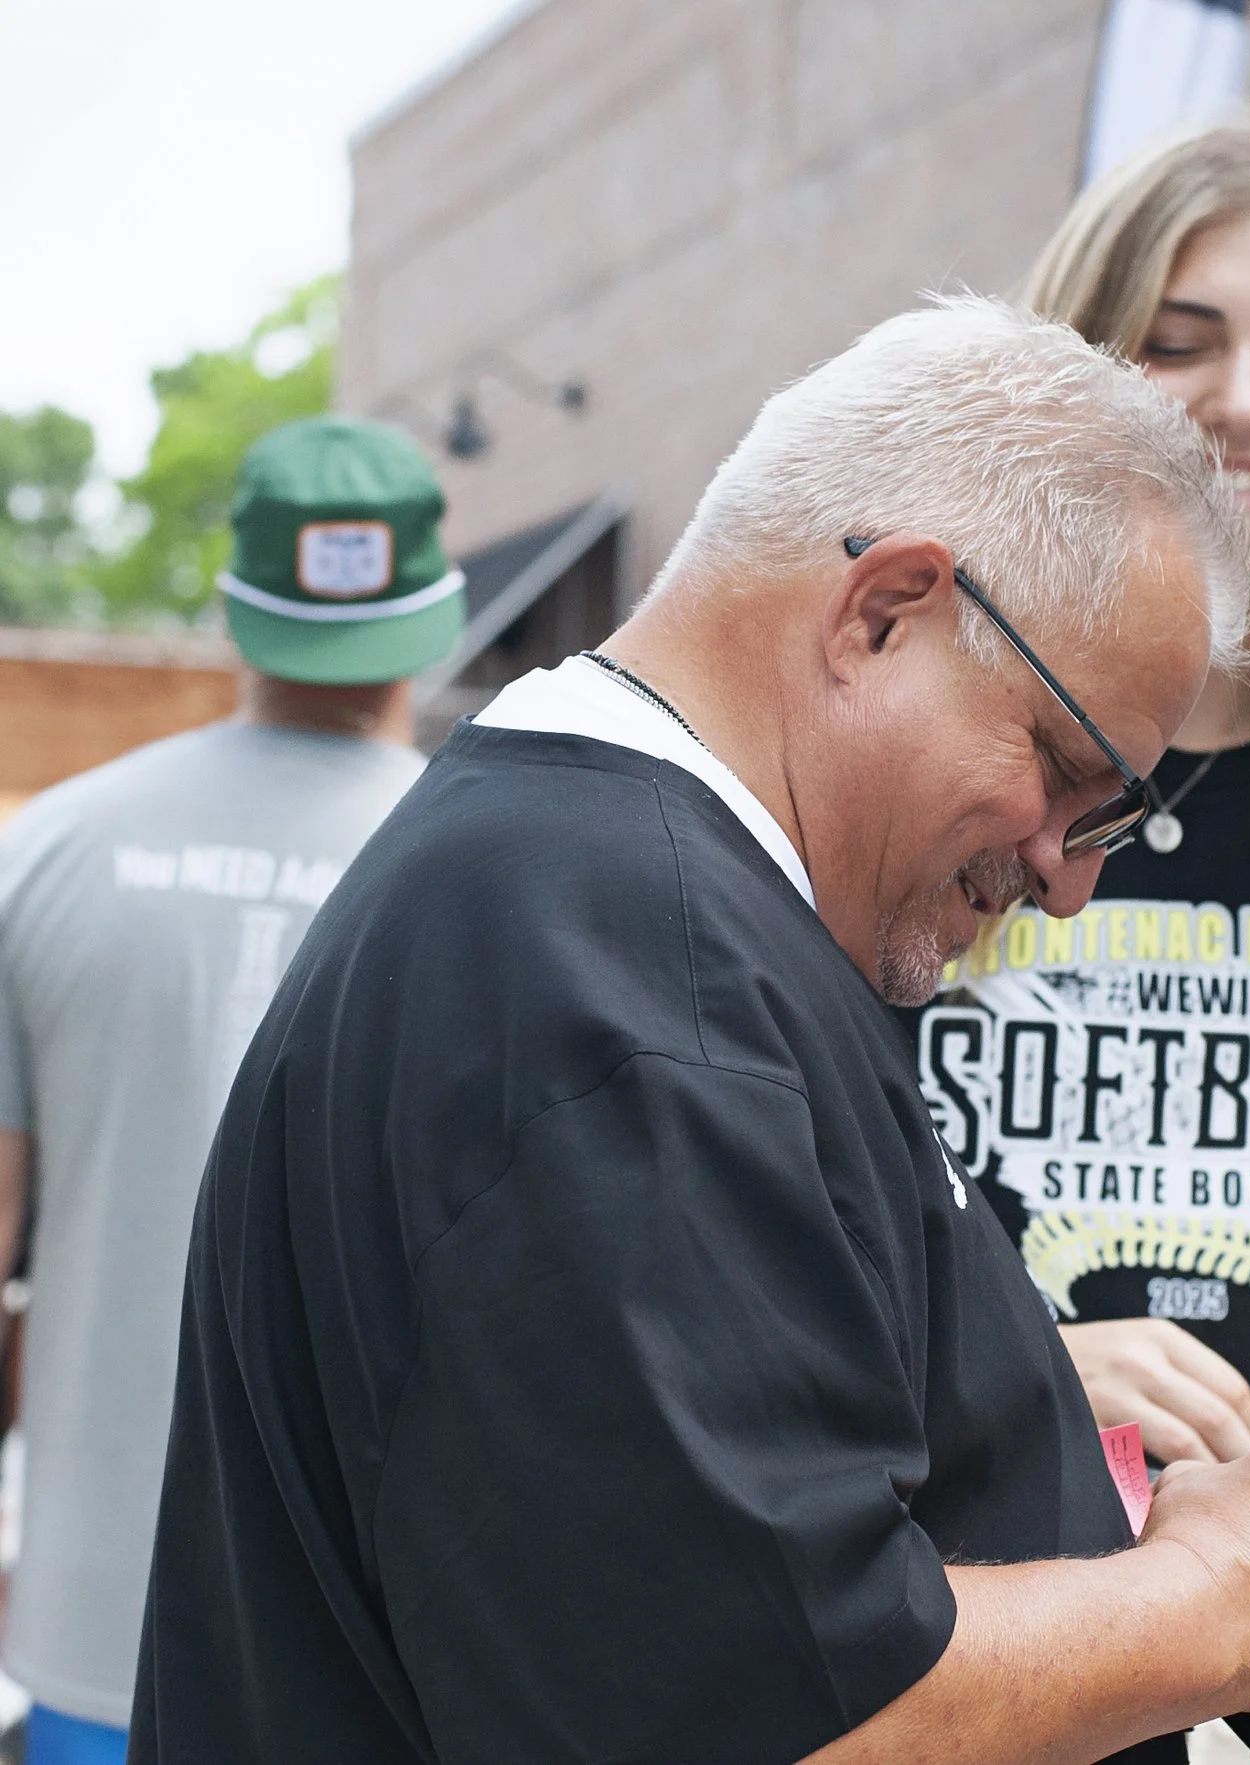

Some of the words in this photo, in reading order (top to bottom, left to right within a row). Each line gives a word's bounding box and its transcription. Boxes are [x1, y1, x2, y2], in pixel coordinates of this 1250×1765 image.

[943, 906, 1227, 981] ONTENAC
[1043, 1160, 1166, 1203] STATE
[1146, 1276, 1230, 1321] 2025
